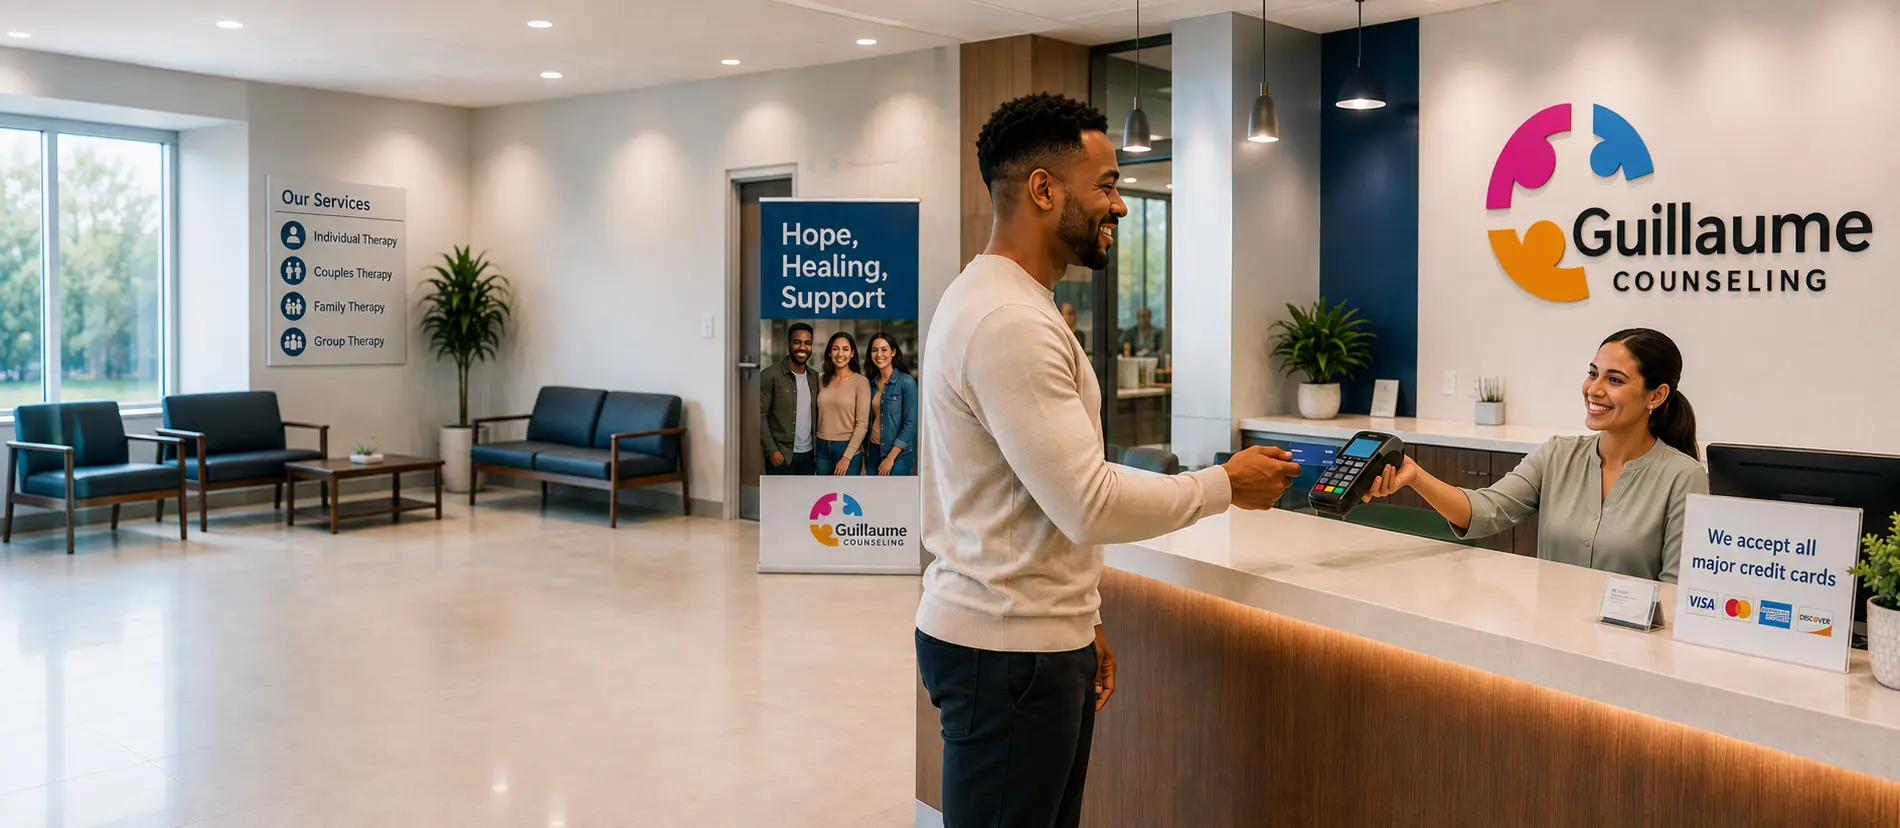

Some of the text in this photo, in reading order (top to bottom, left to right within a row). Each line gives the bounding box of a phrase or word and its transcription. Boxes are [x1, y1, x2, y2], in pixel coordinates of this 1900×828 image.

[281, 189, 370, 211] Our Services
[314, 230, 398, 248] Individual Therapy
[781, 222, 858, 251] Hope,
[1572, 201, 1874, 257] Guillaume
[314, 266, 393, 281] Couples Therapy
[781, 254, 888, 284] Healing,
[1612, 268, 1827, 292] COUNSELING
[314, 300, 385, 314] Family Therapy
[781, 286, 886, 314] Support
[314, 336, 385, 349] Group Therapy
[835, 523, 907, 537] Guillaume
[843, 539, 904, 547] COUNSELING
[1707, 527, 1817, 557] We accept all
[1692, 556, 1836, 587] major credit cards
[1689, 594, 1715, 610] VISA
[1799, 614, 1831, 625] DISCOVER
